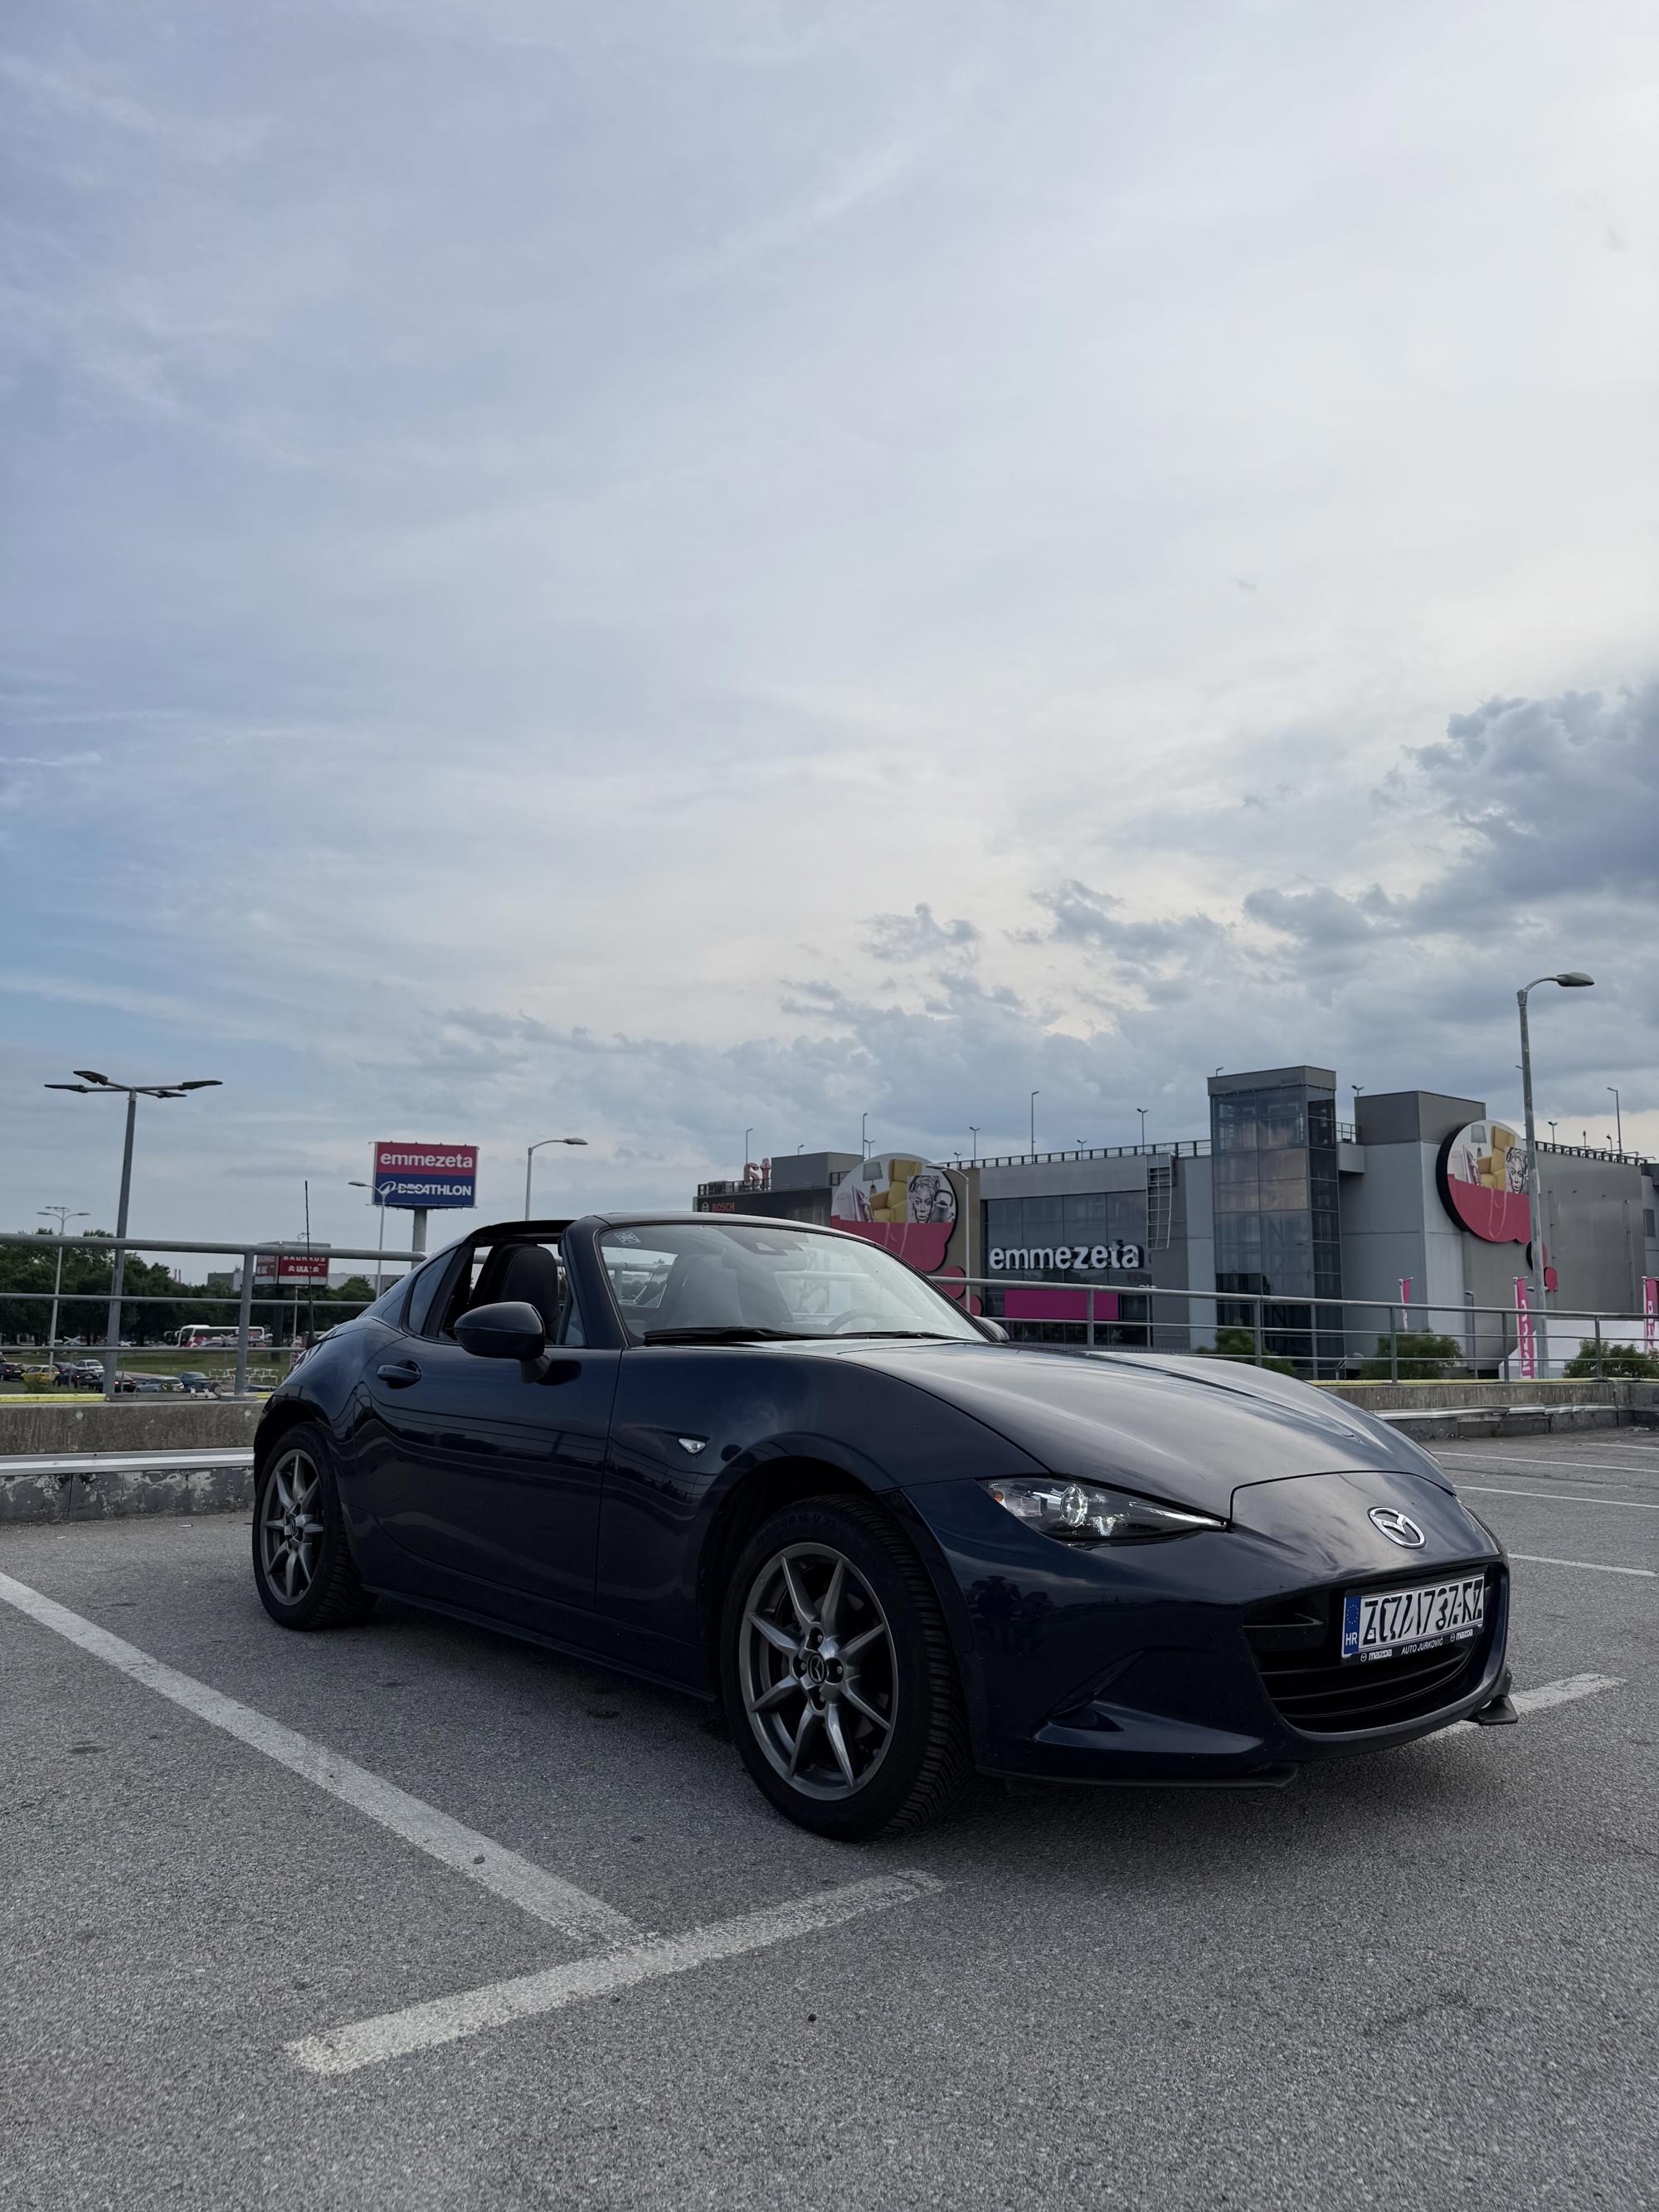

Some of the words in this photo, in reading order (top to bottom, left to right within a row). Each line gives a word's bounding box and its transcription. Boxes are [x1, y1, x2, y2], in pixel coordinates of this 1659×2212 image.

[380, 1153, 473, 1168] emmezeta
[397, 1184, 471, 1196] DECATHLON
[990, 1241, 1142, 1270] emmezeta
[1345, 1632, 1358, 1646] HR
[1369, 1648, 1393, 1660] mazda
[1401, 1644, 1418, 1655] AUTO
[1418, 1637, 1444, 1652] JURKOVIĆ
[1456, 1628, 1473, 1641] mazda
